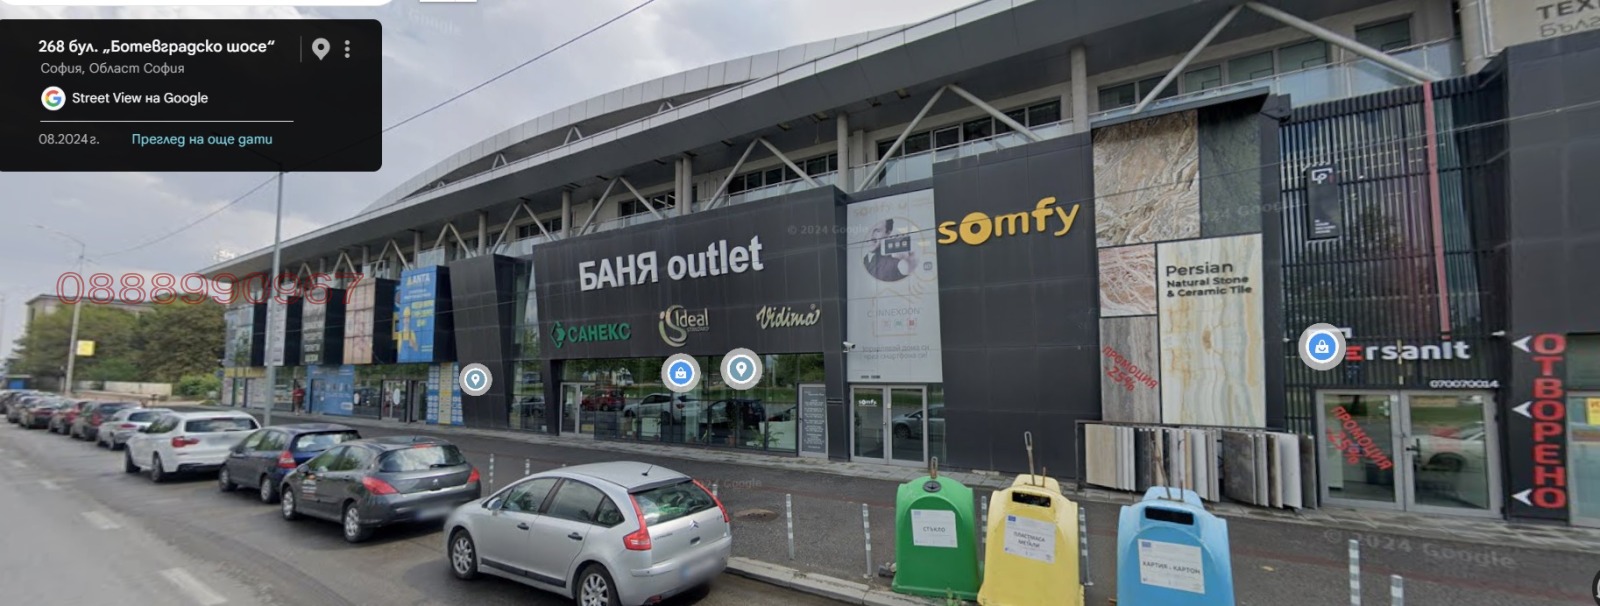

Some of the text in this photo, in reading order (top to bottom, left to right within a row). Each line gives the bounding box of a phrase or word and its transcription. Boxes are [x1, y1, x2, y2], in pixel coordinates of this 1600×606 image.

[1536, 0, 1600, 19] ТЕХ
[937, 196, 1080, 246] somfy
[579, 235, 764, 291] БАНЯ outlet
[1166, 261, 1233, 277] Persian
[1167, 276, 1249, 288] Natural Stone
[1167, 285, 1252, 298] & Ceramic Tile
[675, 307, 709, 328] Ideal
[756, 305, 821, 330] Vidima
[567, 322, 631, 343] САНЕКС
[1103, 345, 1158, 389] ПРОМОЦИЯ
[1428, 378, 1500, 389] 070070014
[1533, 334, 1566, 508] ОТВОРЕНО
[1330, 406, 1393, 470] ПРОМОЦИЯ
